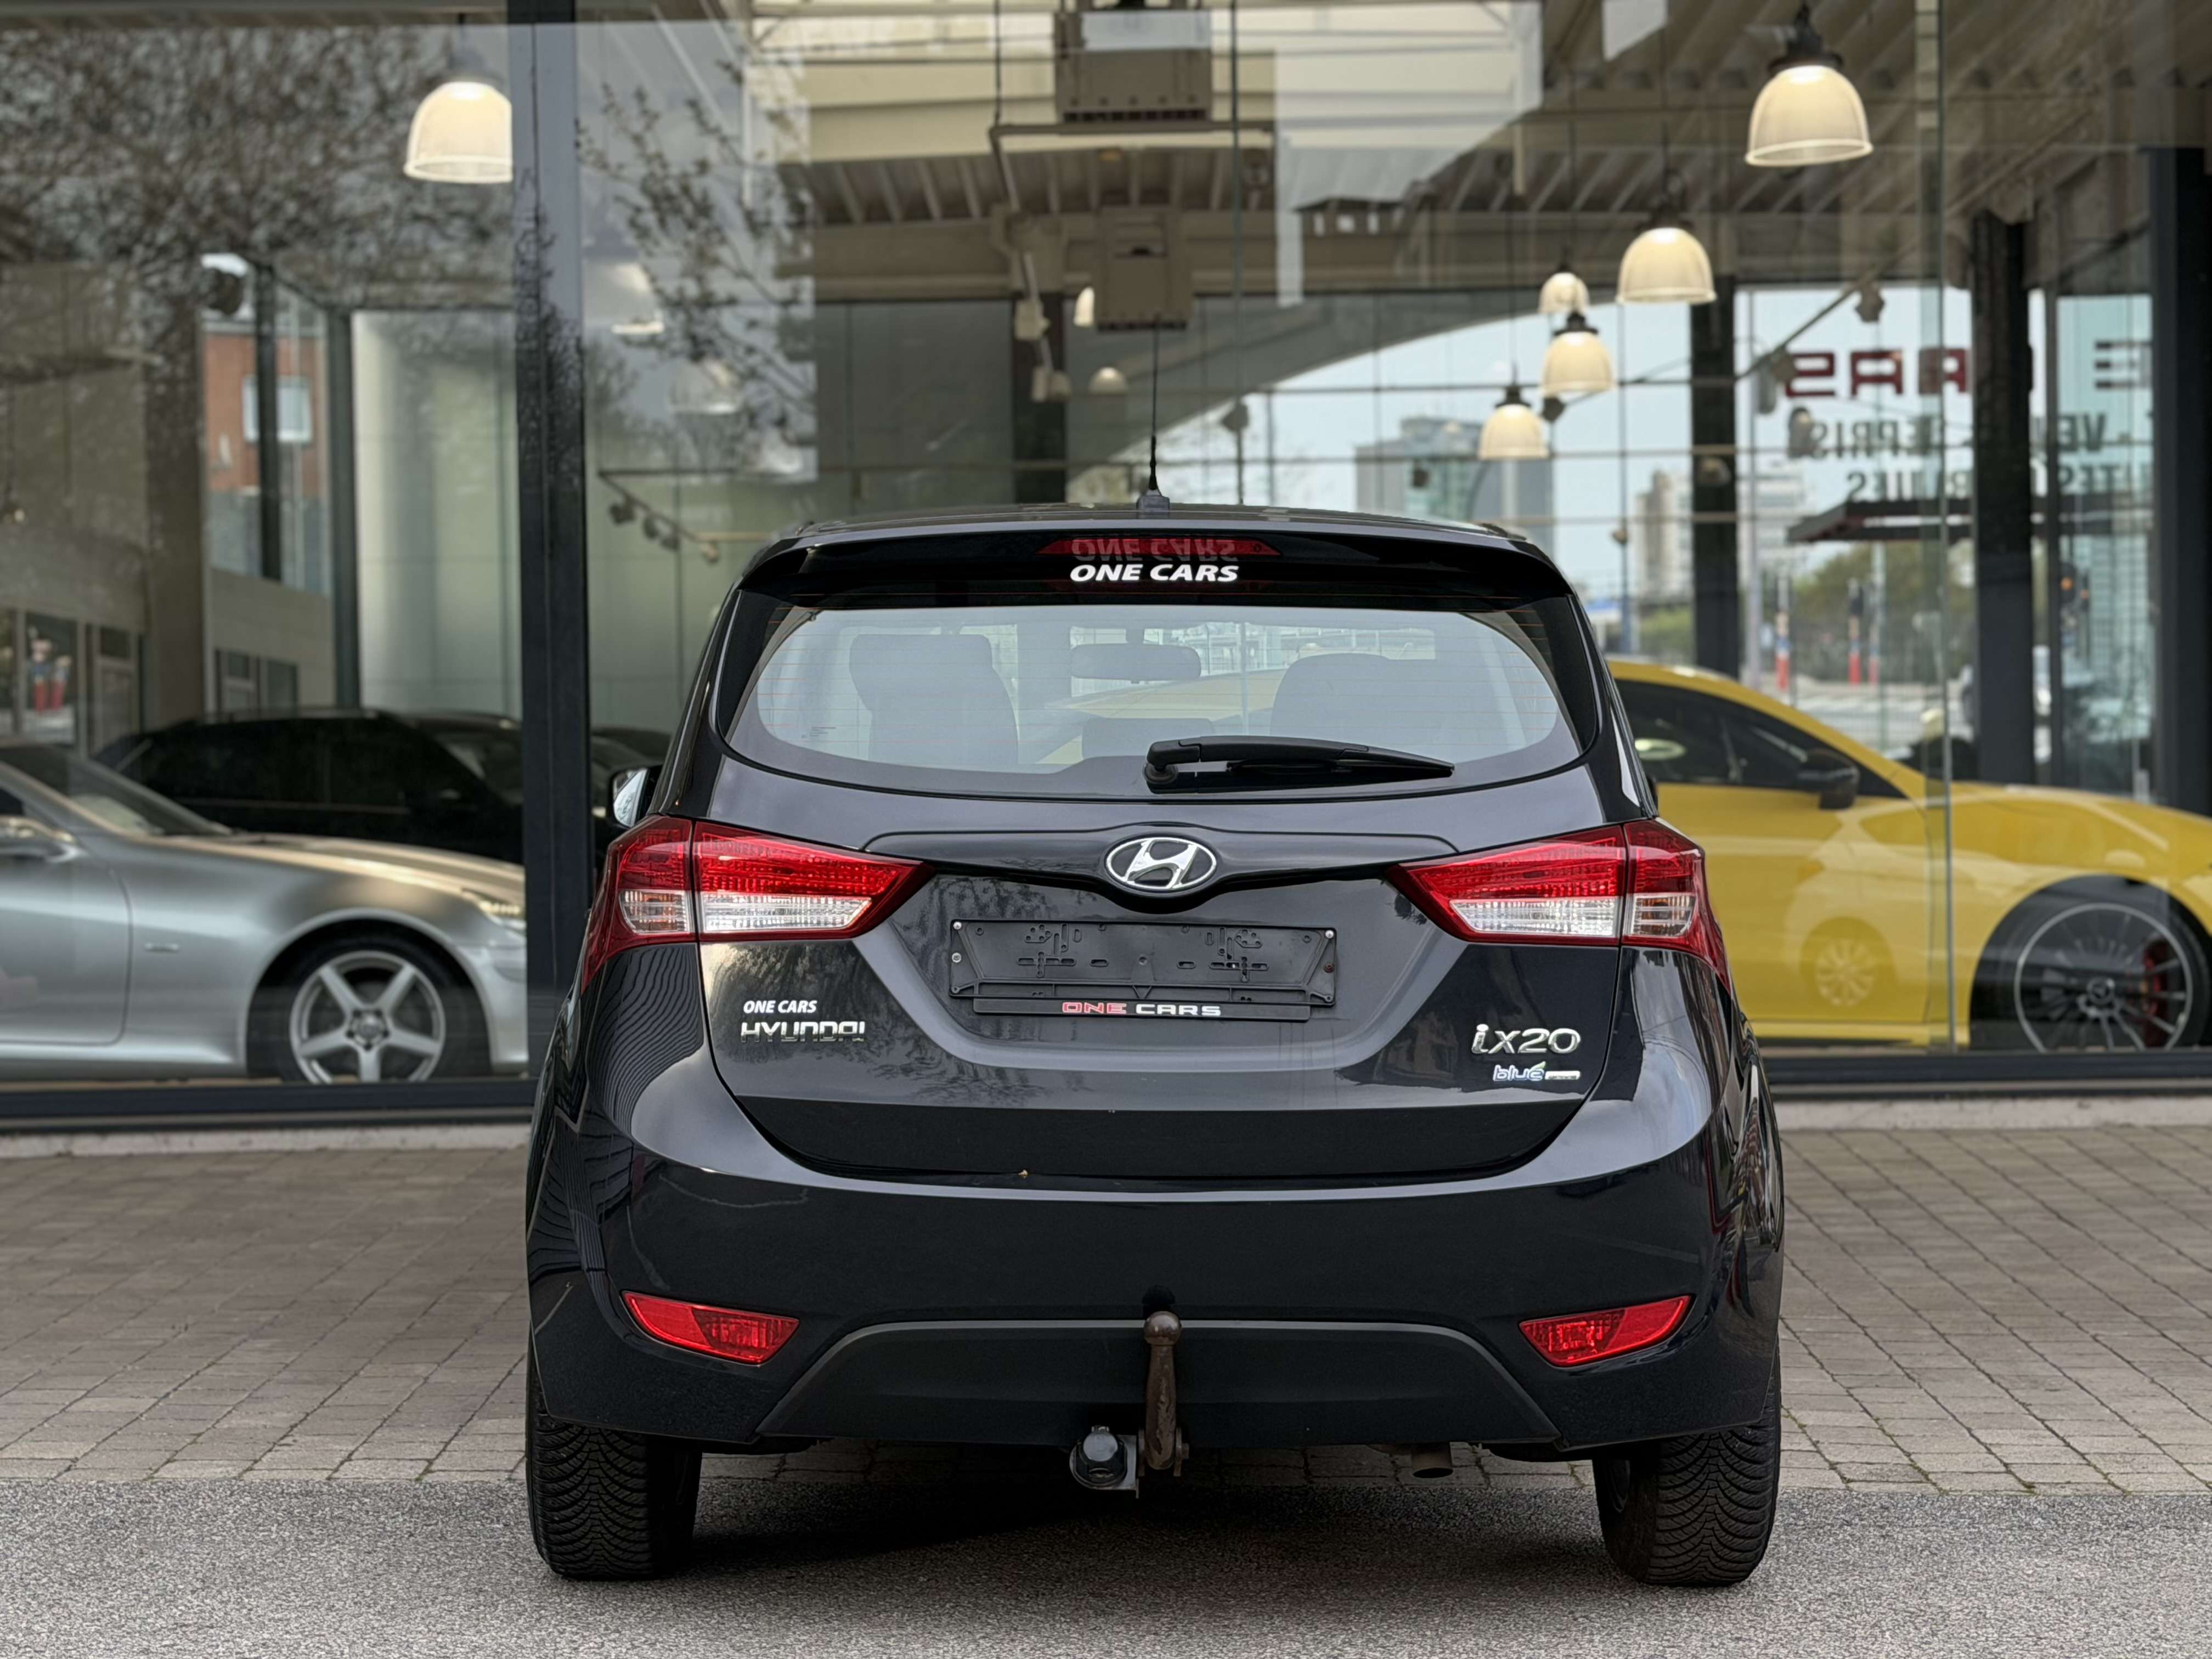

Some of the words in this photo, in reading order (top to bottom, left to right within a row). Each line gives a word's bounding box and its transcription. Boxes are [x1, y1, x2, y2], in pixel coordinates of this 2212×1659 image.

[1070, 563, 1143, 582] ONE
[1150, 563, 1239, 582] CARS
[743, 1000, 776, 1014] ONE
[777, 1000, 817, 1014] CARS
[1062, 1002, 1127, 1014] ONE
[1136, 1003, 1221, 1016] CARS
[741, 1021, 866, 1042] HYUNDAI
[1471, 1024, 1581, 1054] ix20
